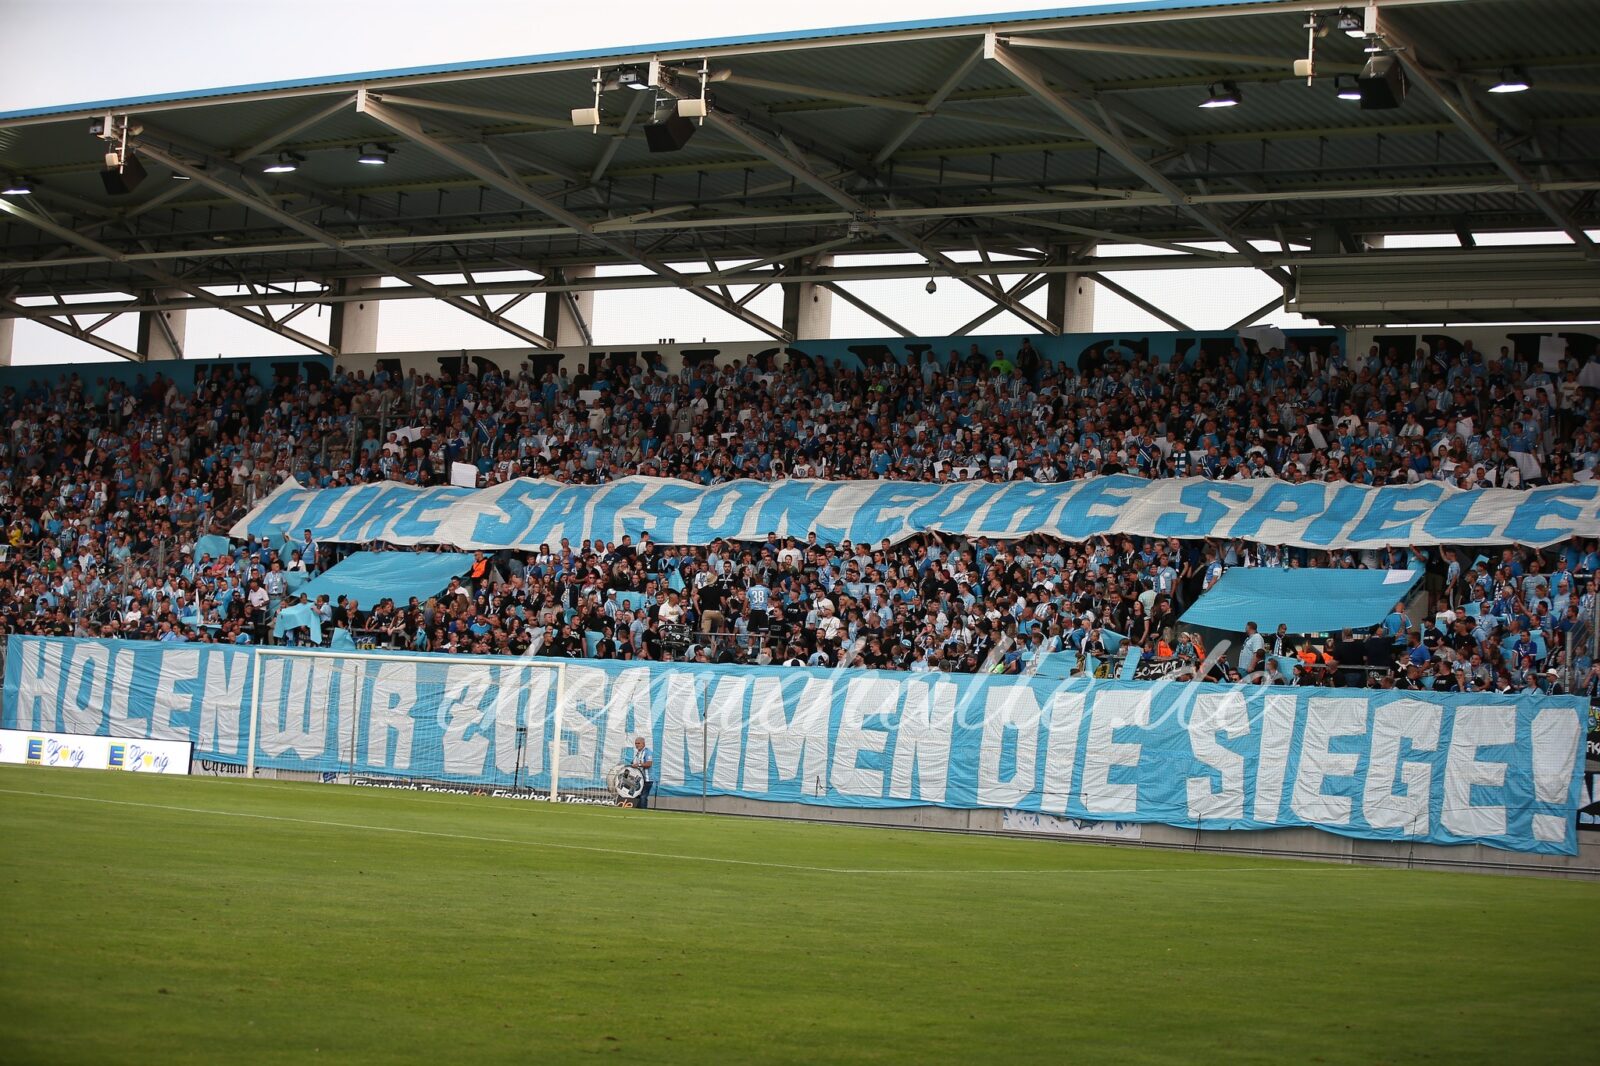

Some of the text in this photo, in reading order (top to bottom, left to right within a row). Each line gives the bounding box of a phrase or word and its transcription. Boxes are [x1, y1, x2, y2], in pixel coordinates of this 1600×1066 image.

[247, 486, 479, 538] EURE
[471, 479, 848, 546] SAISON
[850, 476, 1152, 546] EURE
[752, 590, 764, 603] 38
[16, 640, 1581, 843] HOLEN WIR ZUSAMMEN DIE SIEGE!
[202, 759, 260, 777] Chemnz
